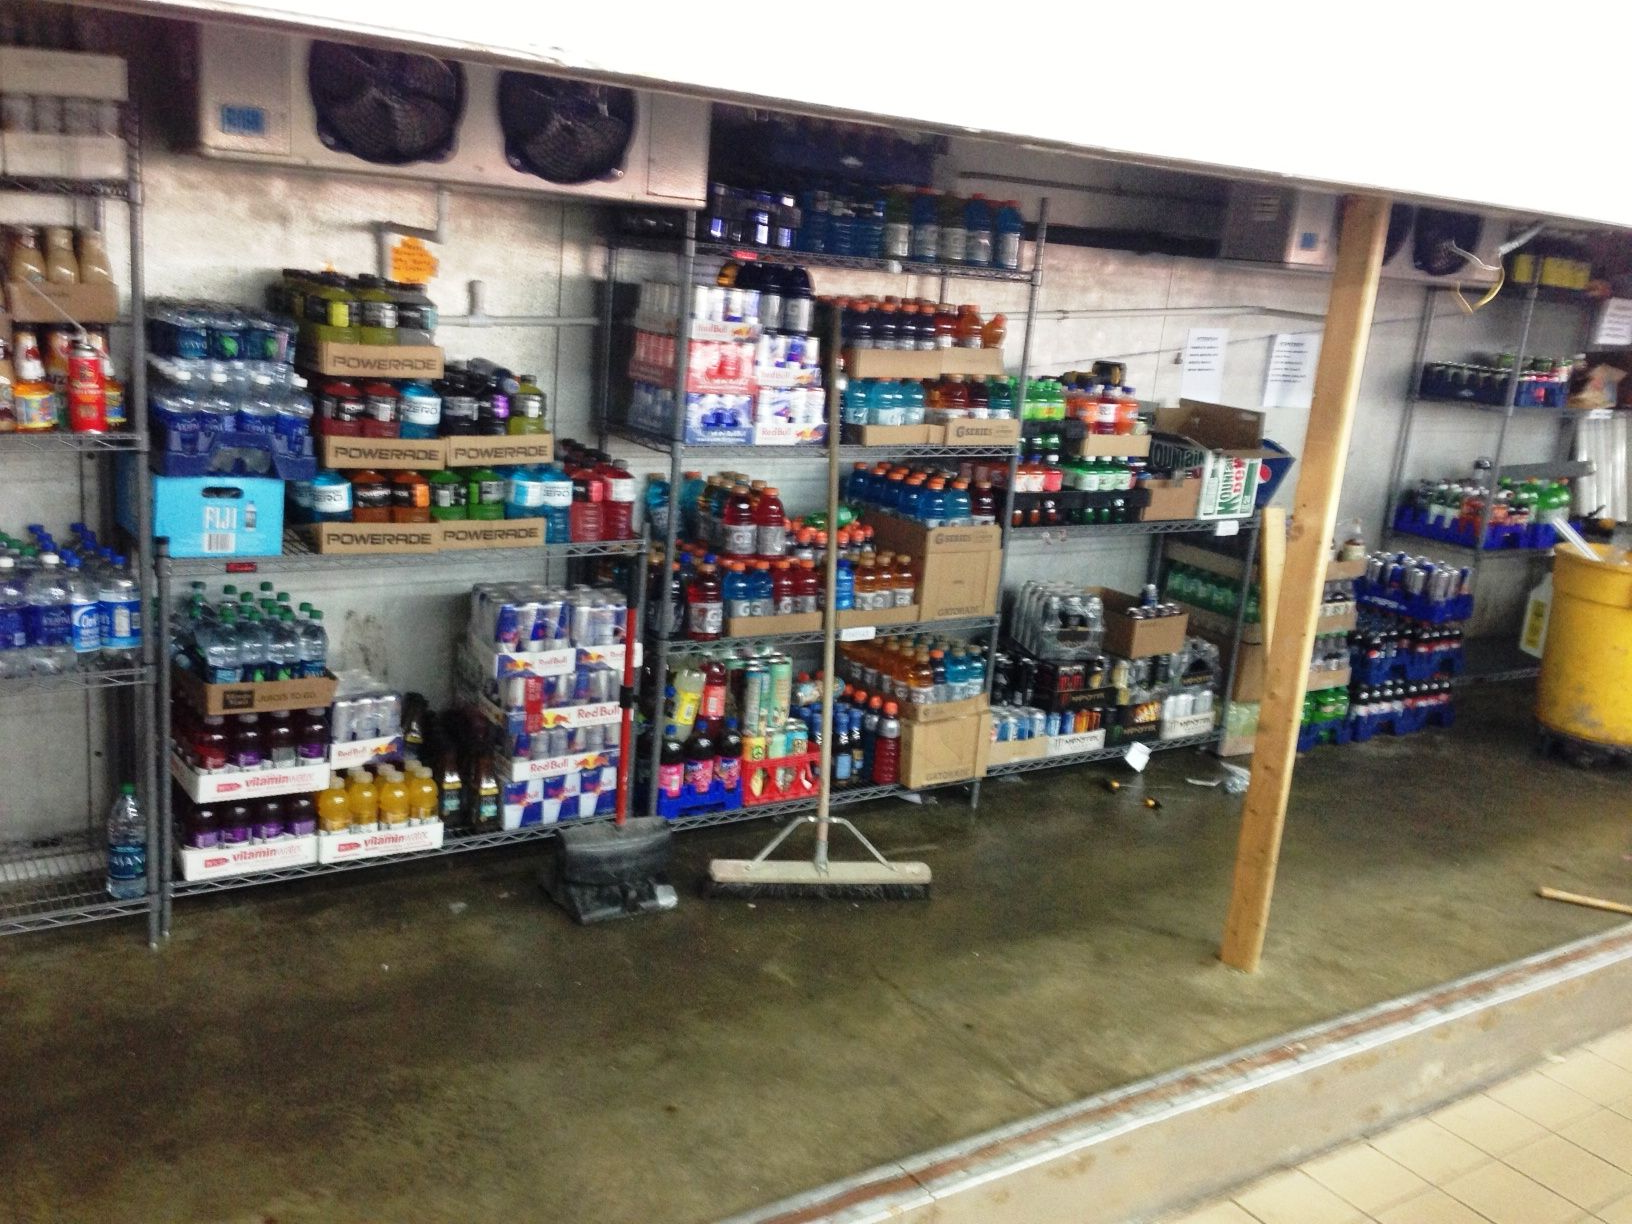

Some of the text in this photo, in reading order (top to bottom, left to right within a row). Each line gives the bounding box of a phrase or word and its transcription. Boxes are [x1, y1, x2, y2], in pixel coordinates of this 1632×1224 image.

[333, 355, 438, 371] POWERADE
[335, 446, 439, 462] POWERADE
[454, 445, 549, 460] POWERADE
[327, 533, 432, 546] POWERADE
[443, 527, 539, 542] POWERADE
[576, 703, 620, 720] Red Bull
[530, 759, 569, 773] Red Bull
